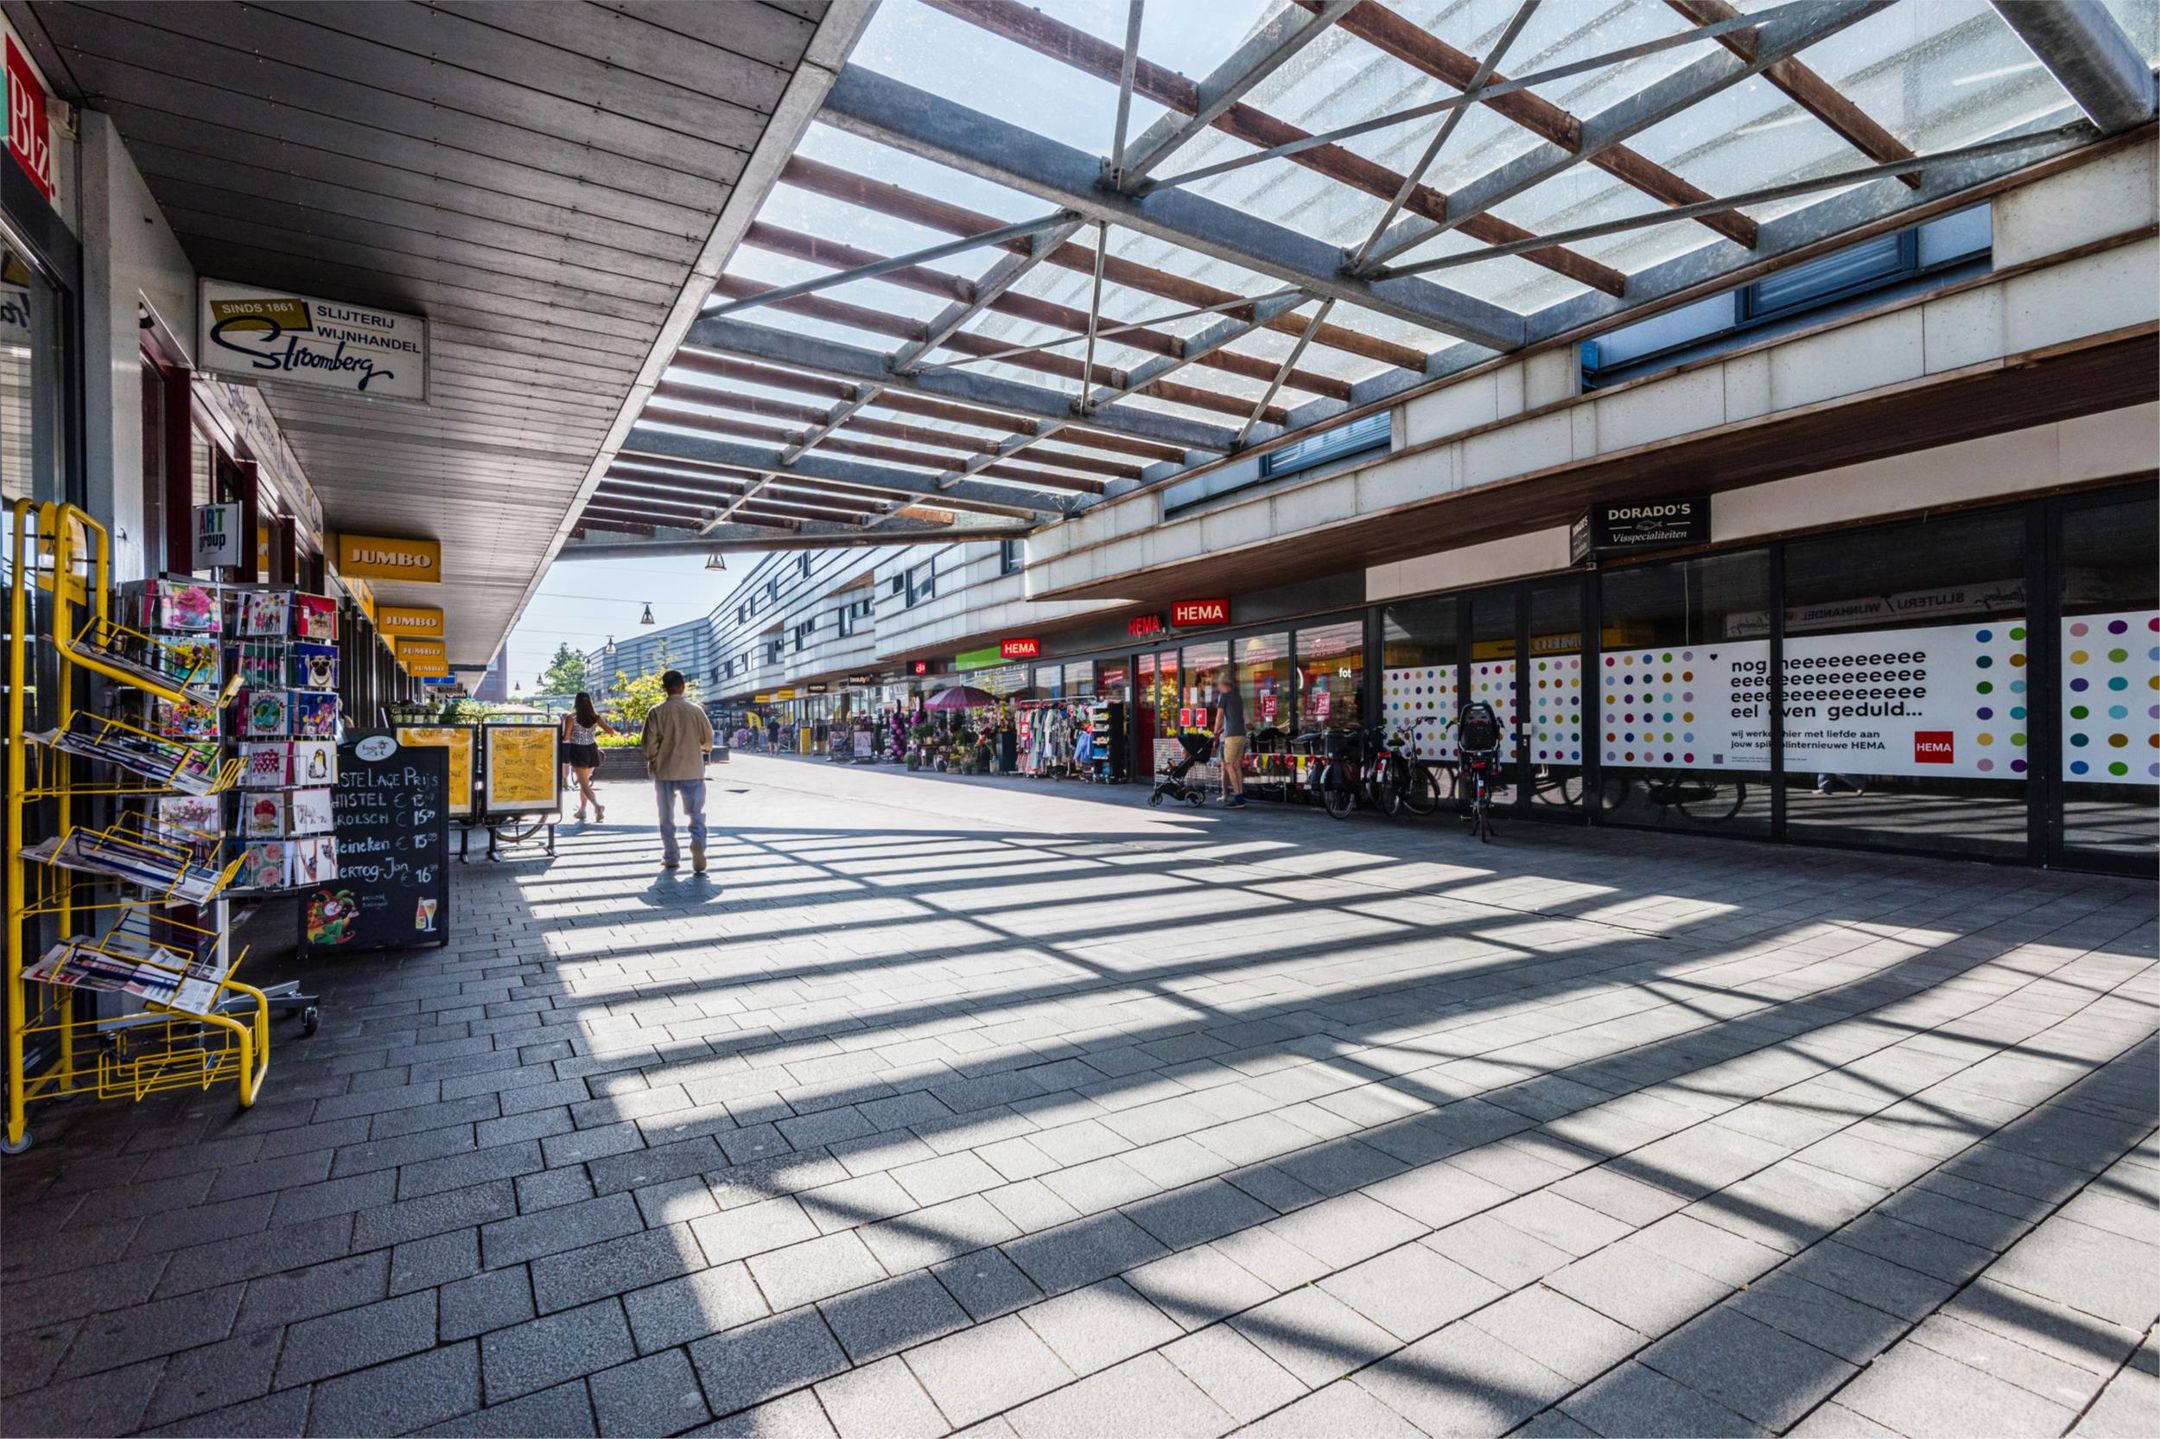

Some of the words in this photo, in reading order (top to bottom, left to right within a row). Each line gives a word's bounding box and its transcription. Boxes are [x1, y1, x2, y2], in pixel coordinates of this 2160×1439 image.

[222, 304, 263, 315] SINDS
[266, 303, 294, 313] 1861
[317, 305, 395, 329] SLIJTERIJ
[317, 326, 422, 354] WIJNHANDEL
[210, 315, 395, 391] Stroomberg
[1608, 503, 1692, 521] DORADO'S
[200, 508, 226, 533] ART
[199, 533, 226, 553] group
[1612, 530, 1688, 544] Visspecialiteiten
[352, 548, 432, 569] JUMBO
[1176, 605, 1223, 620] HEMA
[386, 616, 437, 628] JUMBO
[1128, 614, 1160, 636] HEMA
[403, 647, 440, 656] JUMBO
[1005, 643, 1035, 654] HEMA
[1731, 660, 1767, 674] nog
[1731, 704, 1759, 718] eel
[1731, 730, 1744, 739] wij
[1746, 730, 1771, 738] werke
[1804, 730, 1824, 738] met
[1826, 729, 1857, 738] liefde
[1859, 730, 1880, 738] aan
[1730, 740, 1752, 750] jouw
[1851, 741, 1885, 750] HEMA
[1916, 742, 1952, 752] HEMA
[334, 771, 366, 788] STE
[336, 813, 389, 826] ROLSCH
